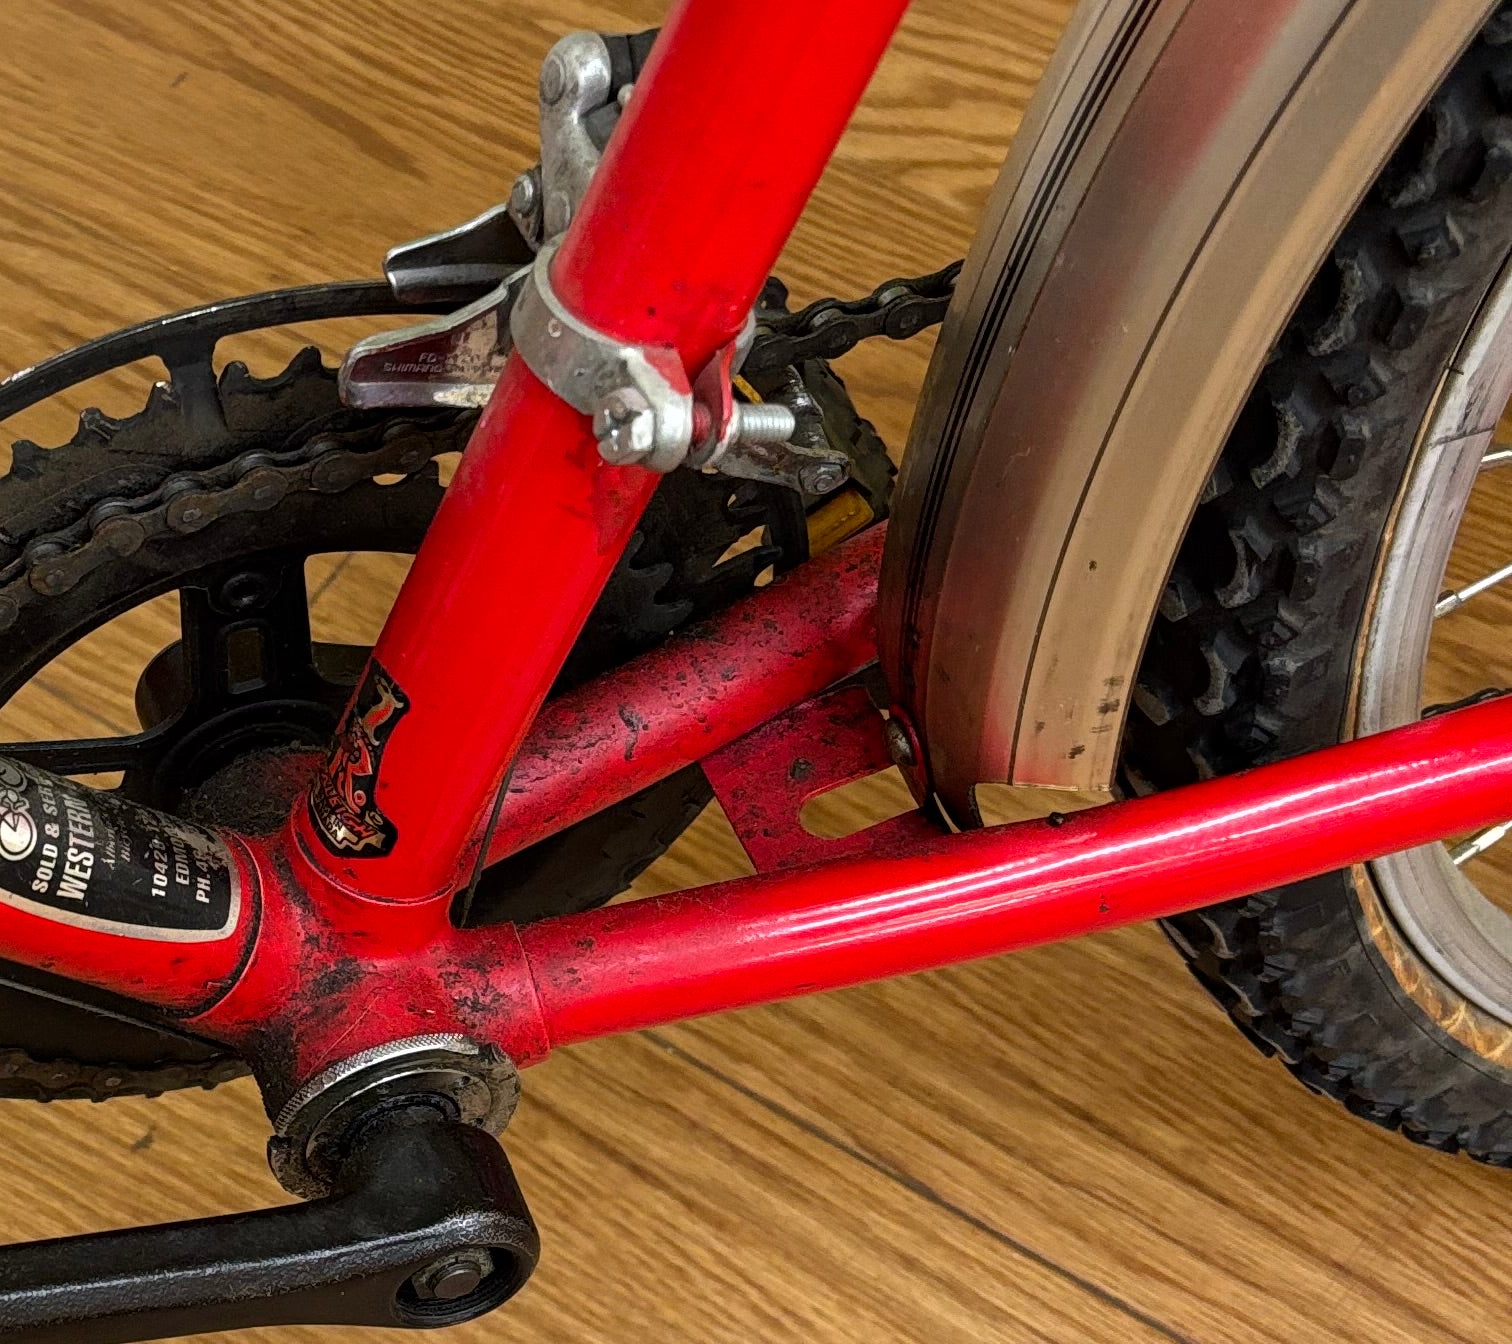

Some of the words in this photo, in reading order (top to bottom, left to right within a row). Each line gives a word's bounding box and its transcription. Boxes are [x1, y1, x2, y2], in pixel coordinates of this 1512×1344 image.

[44, 822, 60, 839] &
[55, 792, 95, 902] WESTERN
[31, 843, 59, 894] SOLD
